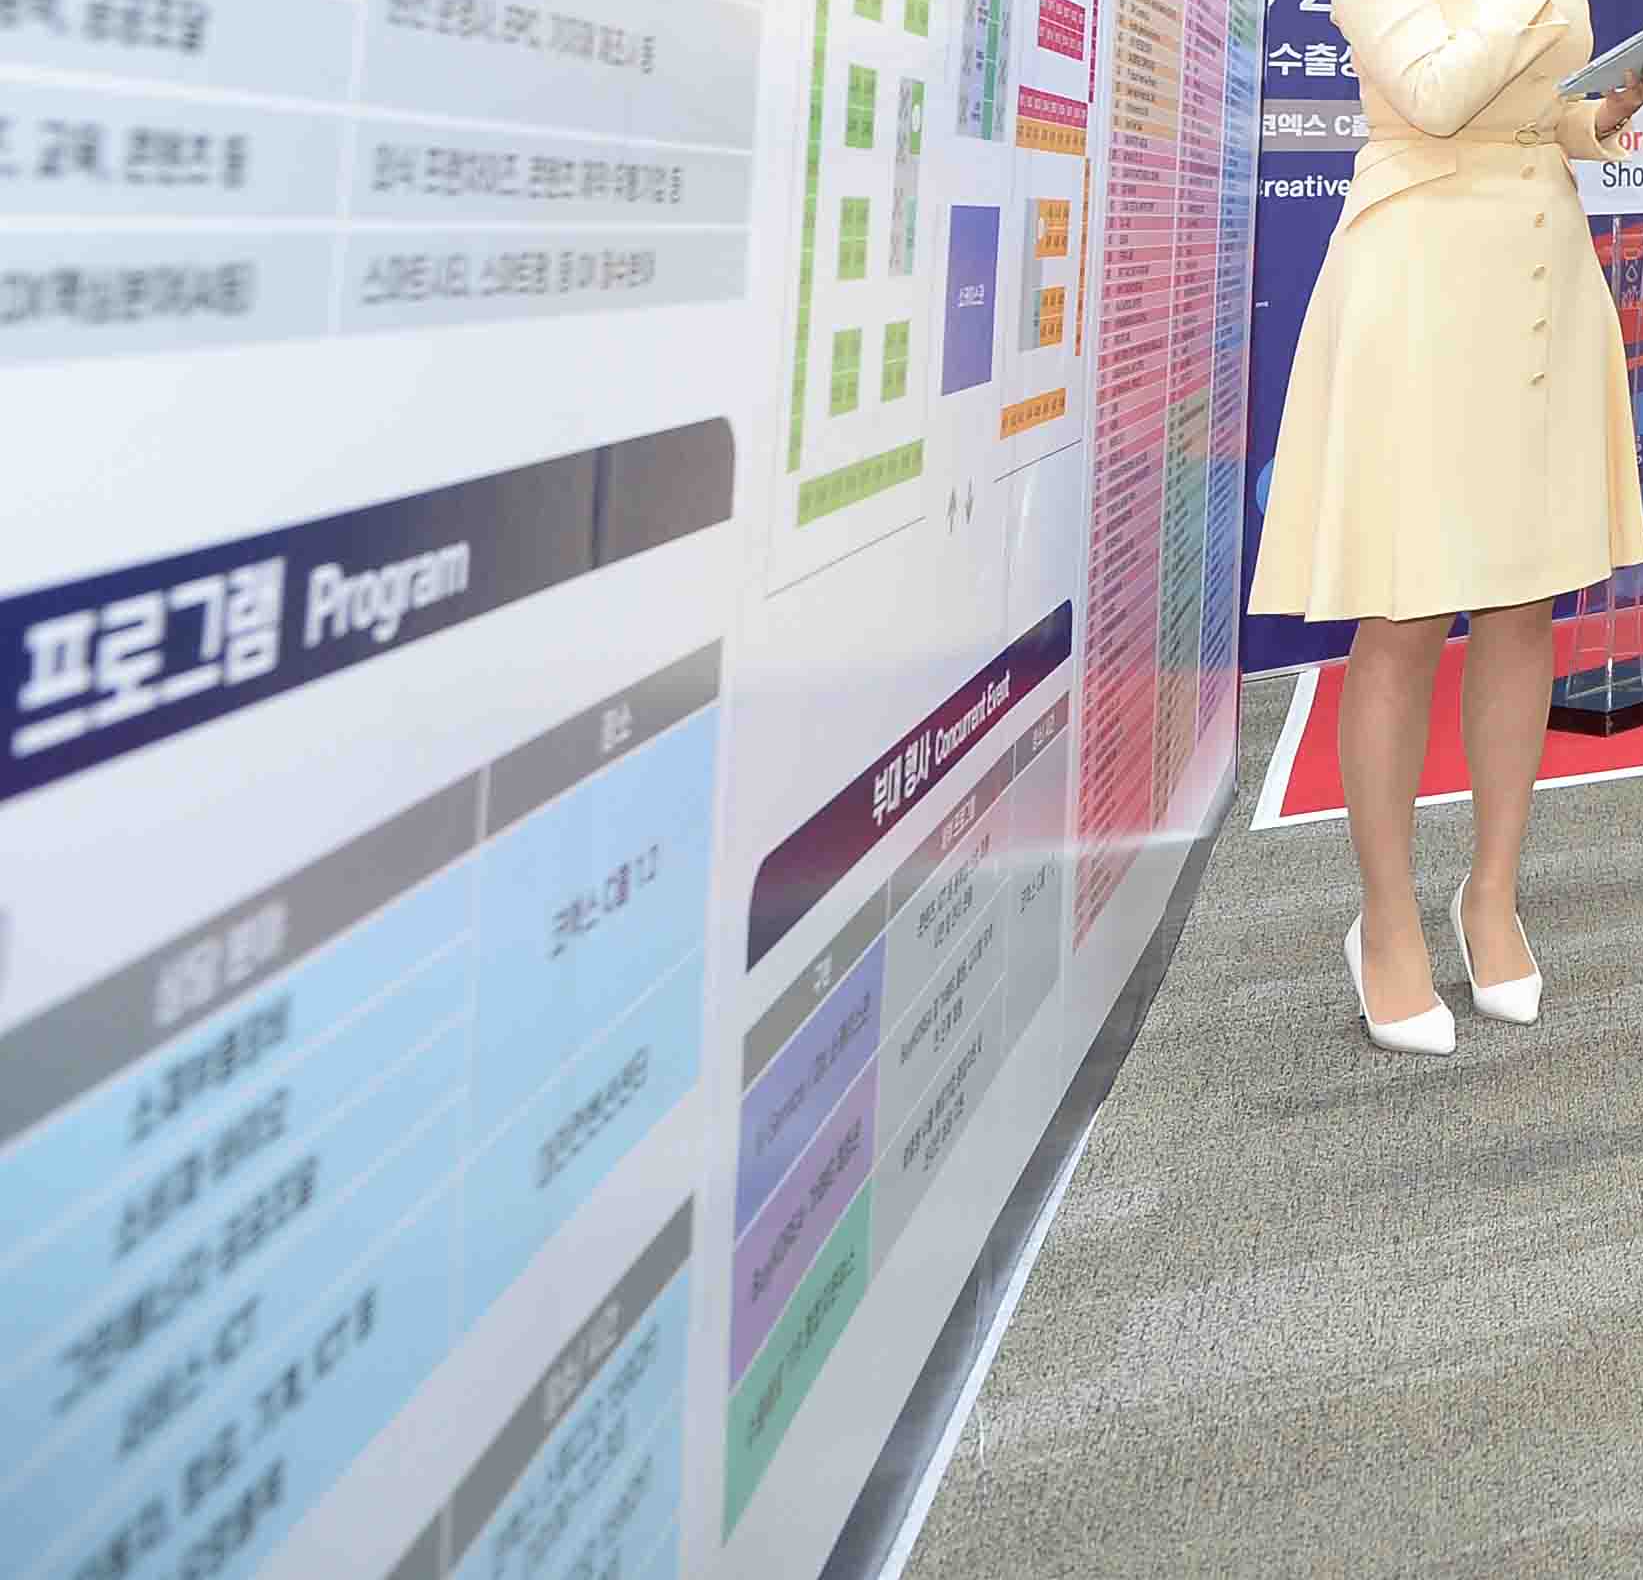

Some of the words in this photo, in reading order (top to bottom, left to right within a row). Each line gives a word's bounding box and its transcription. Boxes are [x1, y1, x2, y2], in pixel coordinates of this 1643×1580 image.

[12, 556, 285, 758] 프로그램
[303, 542, 470, 648] Program
[873, 755, 902, 826] 부대
[904, 731, 930, 798] 행사
[935, 691, 986, 766] Concurrent
[986, 668, 1010, 717] Event
